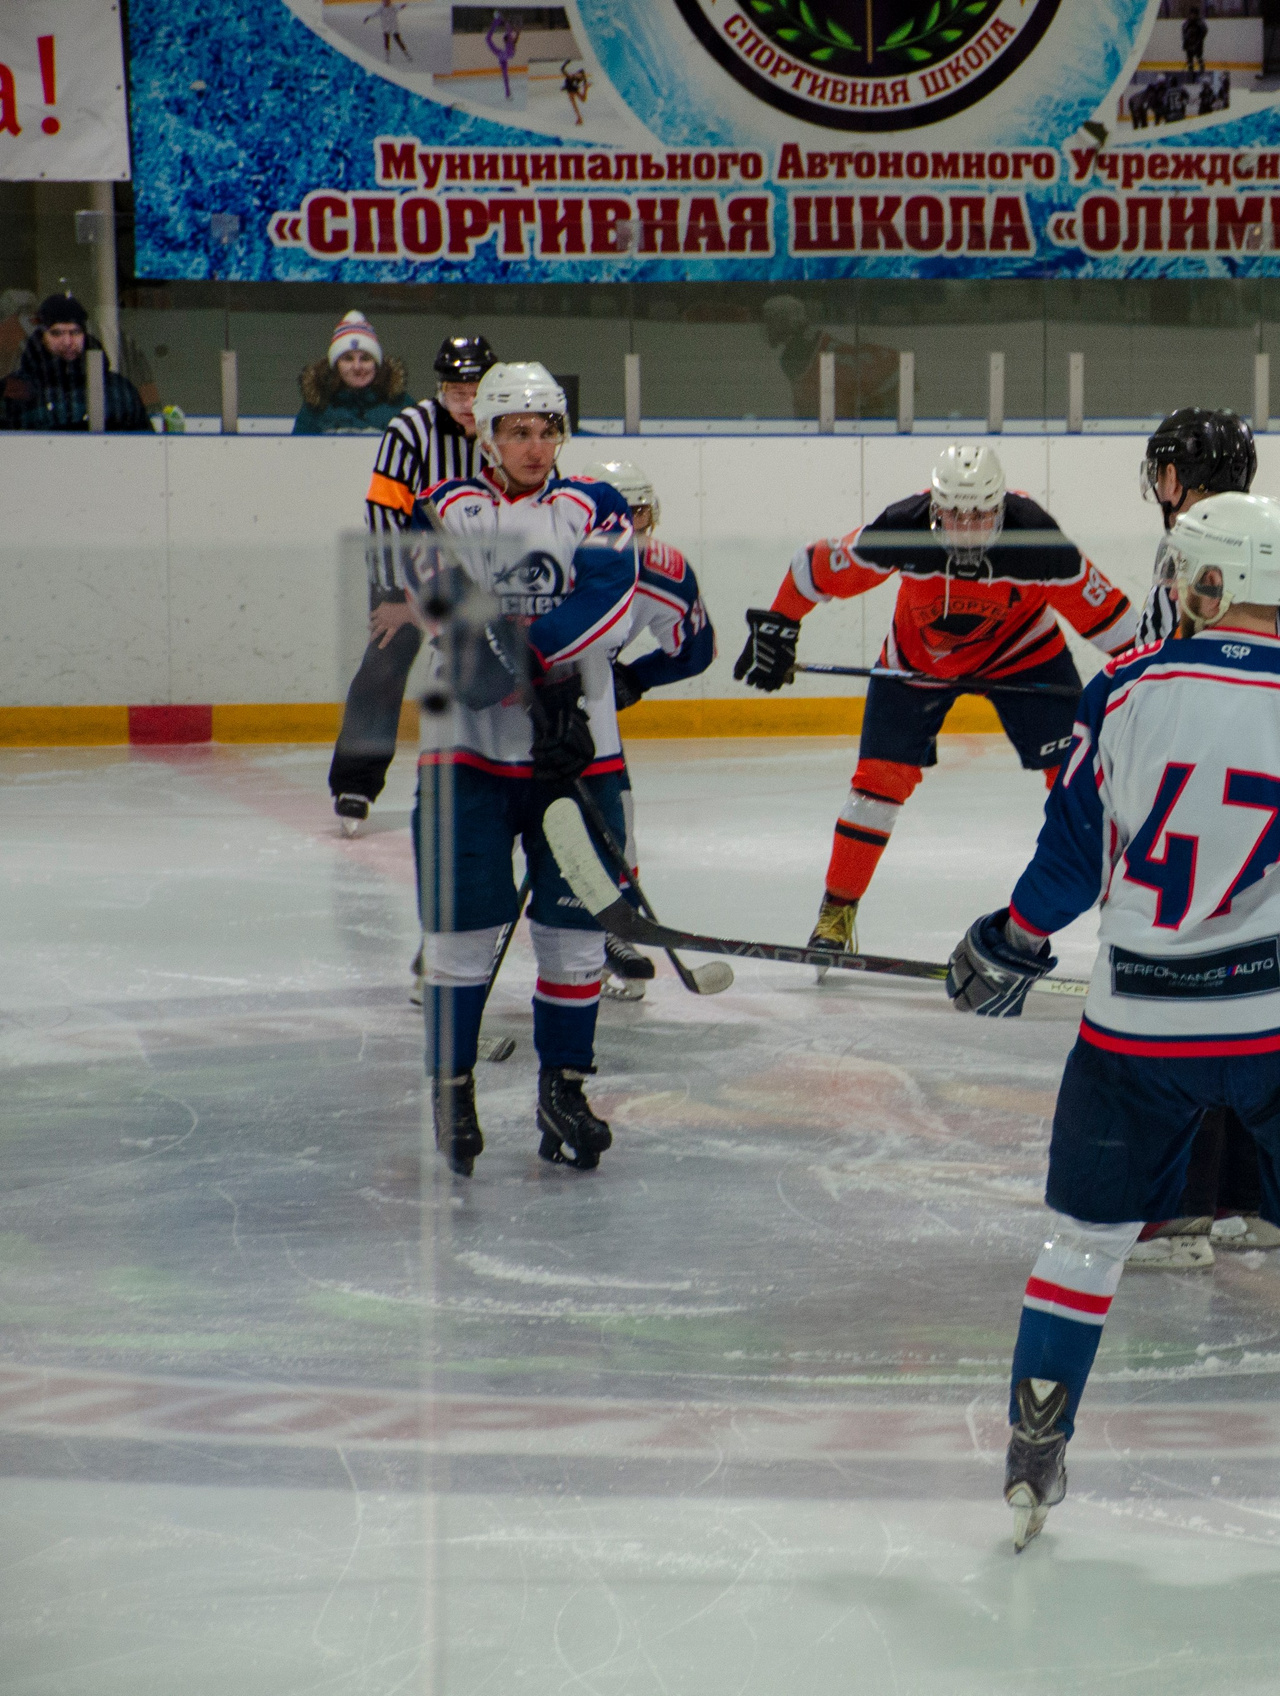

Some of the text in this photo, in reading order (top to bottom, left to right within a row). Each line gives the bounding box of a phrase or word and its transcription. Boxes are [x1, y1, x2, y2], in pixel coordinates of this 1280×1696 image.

[723, 14, 1017, 107] СПОРТИВНАЯ ШКОЛА
[380, 143, 763, 190] Муниципального
[777, 143, 1056, 180] Автономного
[274, 196, 771, 255] «СПОРТИВНАЯ
[793, 196, 1031, 252] ШКОЛА
[758, 622, 800, 640] CC
[1040, 735, 1073, 757] CC
